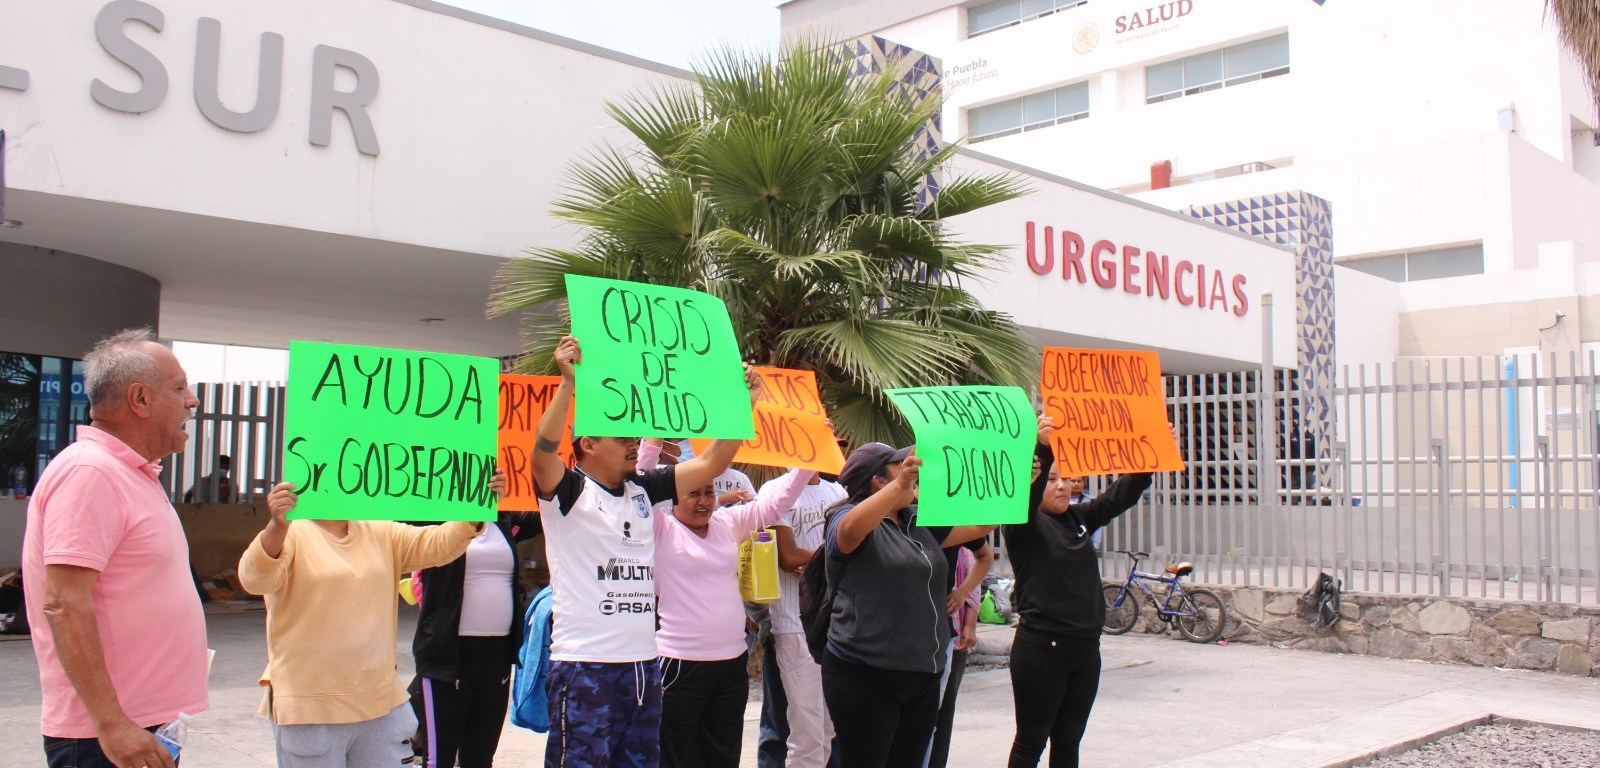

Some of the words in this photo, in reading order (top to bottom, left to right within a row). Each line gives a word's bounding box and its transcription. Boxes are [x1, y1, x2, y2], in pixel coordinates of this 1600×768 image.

[1115, 0, 1193, 34] SALUD
[90, 0, 381, 156] SUR
[953, 58, 988, 75] Puebla
[1026, 221, 1249, 317] URGENCIAS
[601, 287, 711, 355] CRISIS
[311, 353, 482, 424] AYUDA
[641, 352, 678, 389] DE
[1042, 351, 1156, 397] GOBERNADOR
[601, 377, 707, 434] SALUD
[894, 390, 1020, 439] TRABAJO
[1047, 395, 1134, 433] SALOMON
[943, 445, 1015, 500] DIGNO
[1057, 435, 1159, 474] AYUDENOS
